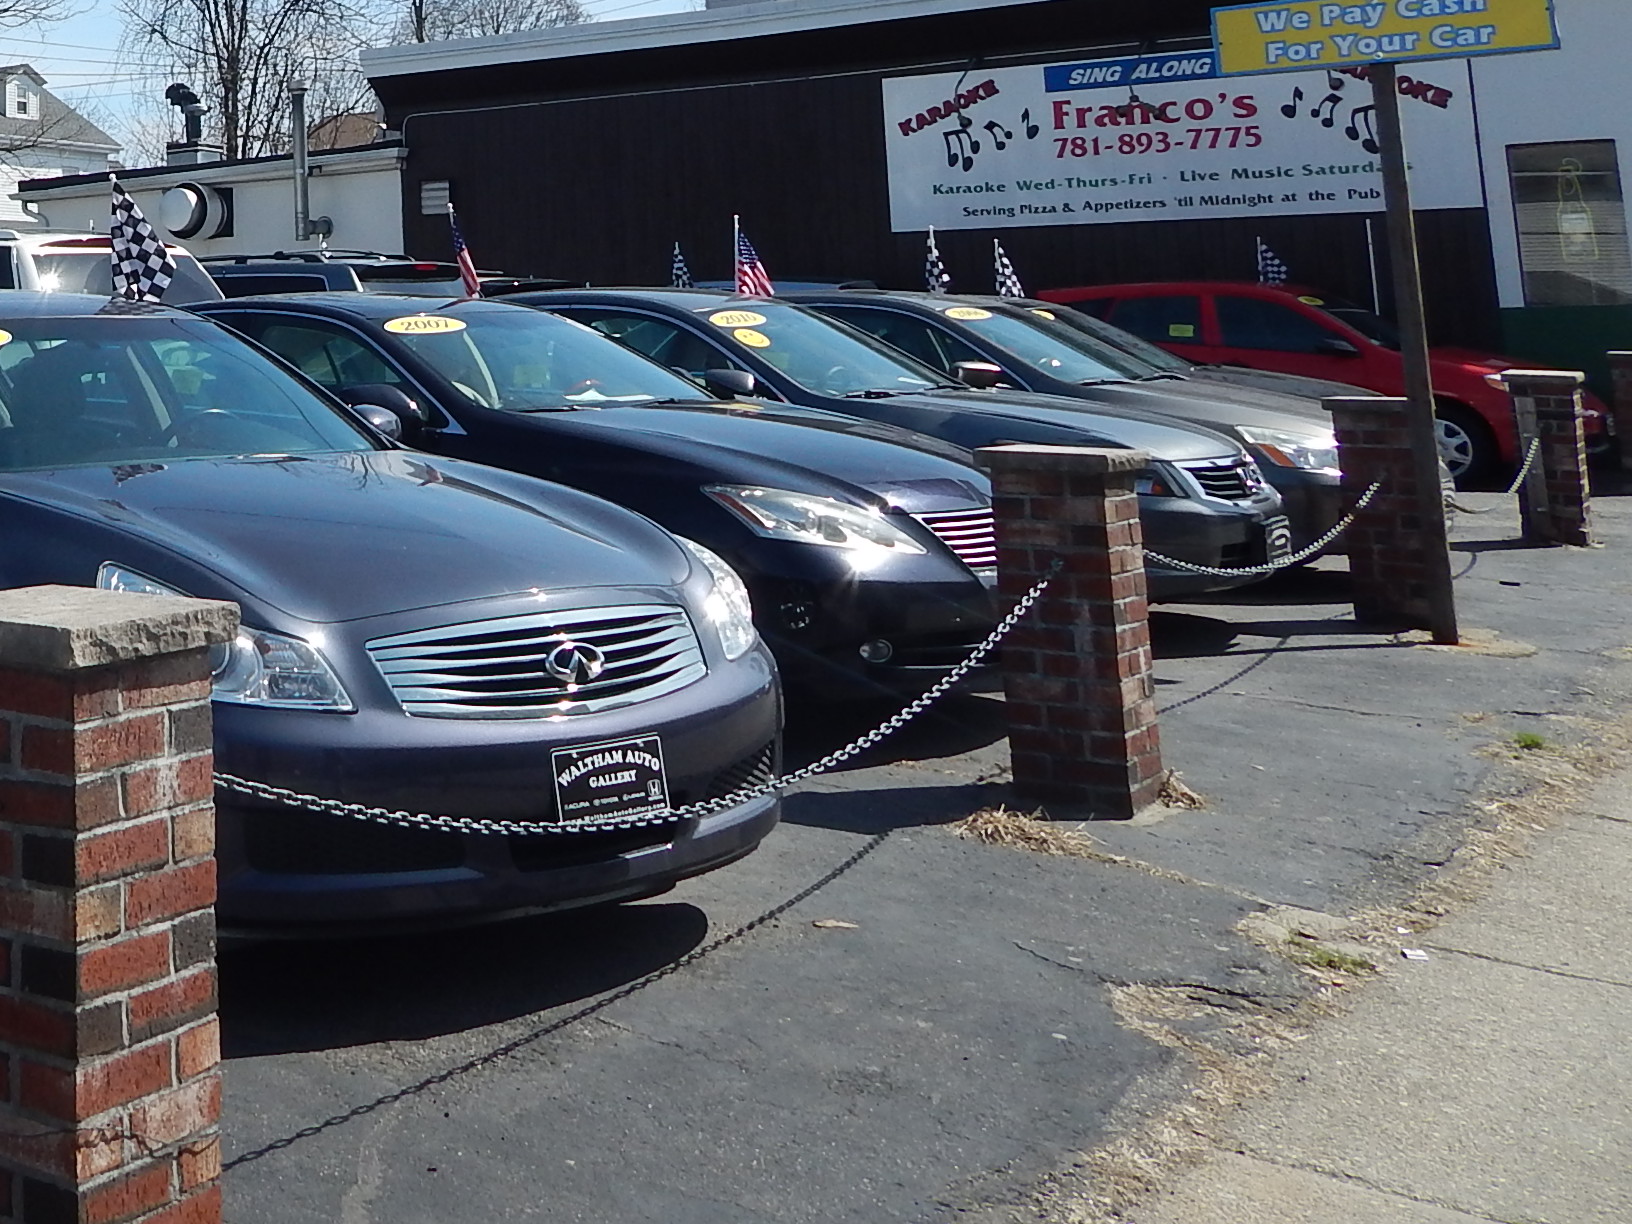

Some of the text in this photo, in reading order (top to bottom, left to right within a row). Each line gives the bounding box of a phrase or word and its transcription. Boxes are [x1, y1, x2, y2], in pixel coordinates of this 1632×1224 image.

[1256, 8, 1310, 33] We
[1322, 2, 1384, 27] Pay
[1267, 24, 1495, 63] For Your Car
[1069, 58, 1212, 85] SING ALONG
[898, 79, 1000, 136] KARAOKE
[1052, 93, 1258, 130] Franco's
[1053, 126, 1262, 158] 781-893-7775
[933, 181, 1006, 195] Karaoke
[1016, 173, 1152, 191] Wed-Thurs-Fri
[1180, 169, 1220, 182] Live
[1231, 165, 1295, 180] Music
[963, 205, 1016, 218] Serving
[1020, 203, 1057, 214] Pizza
[1062, 202, 1075, 213] &
[1082, 199, 1167, 212] Appetizers
[1199, 192, 1274, 208] Midnight
[1281, 192, 1297, 202] at
[1308, 190, 1336, 201] the
[1347, 188, 1381, 200] Pub
[558, 750, 660, 787] WALTHAM AUTO
[589, 770, 637, 788] GALLERY
